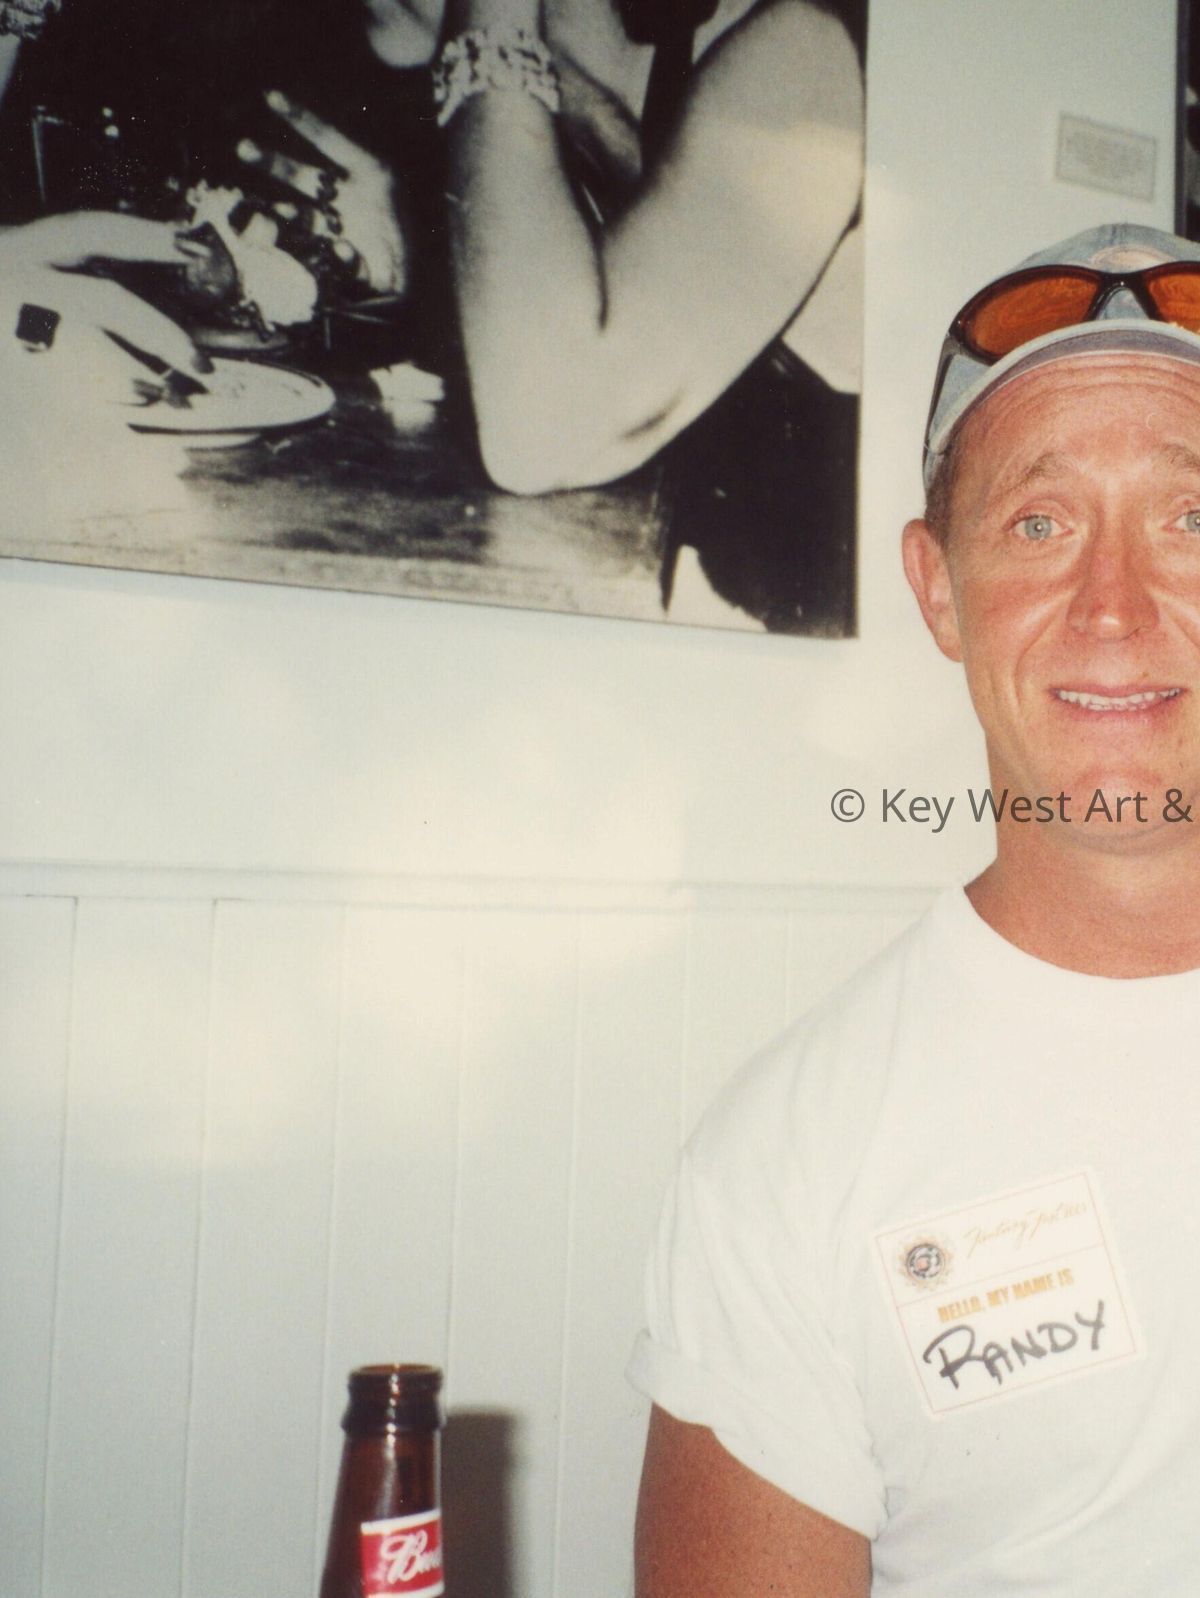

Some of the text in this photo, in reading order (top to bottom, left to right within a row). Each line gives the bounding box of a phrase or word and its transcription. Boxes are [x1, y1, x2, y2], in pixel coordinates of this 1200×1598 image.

[986, 1285, 1010, 1308] MY
[1012, 1273, 1054, 1301] NAME
[1056, 1267, 1075, 1288] IS
[922, 1299, 1106, 1389] RANDY
